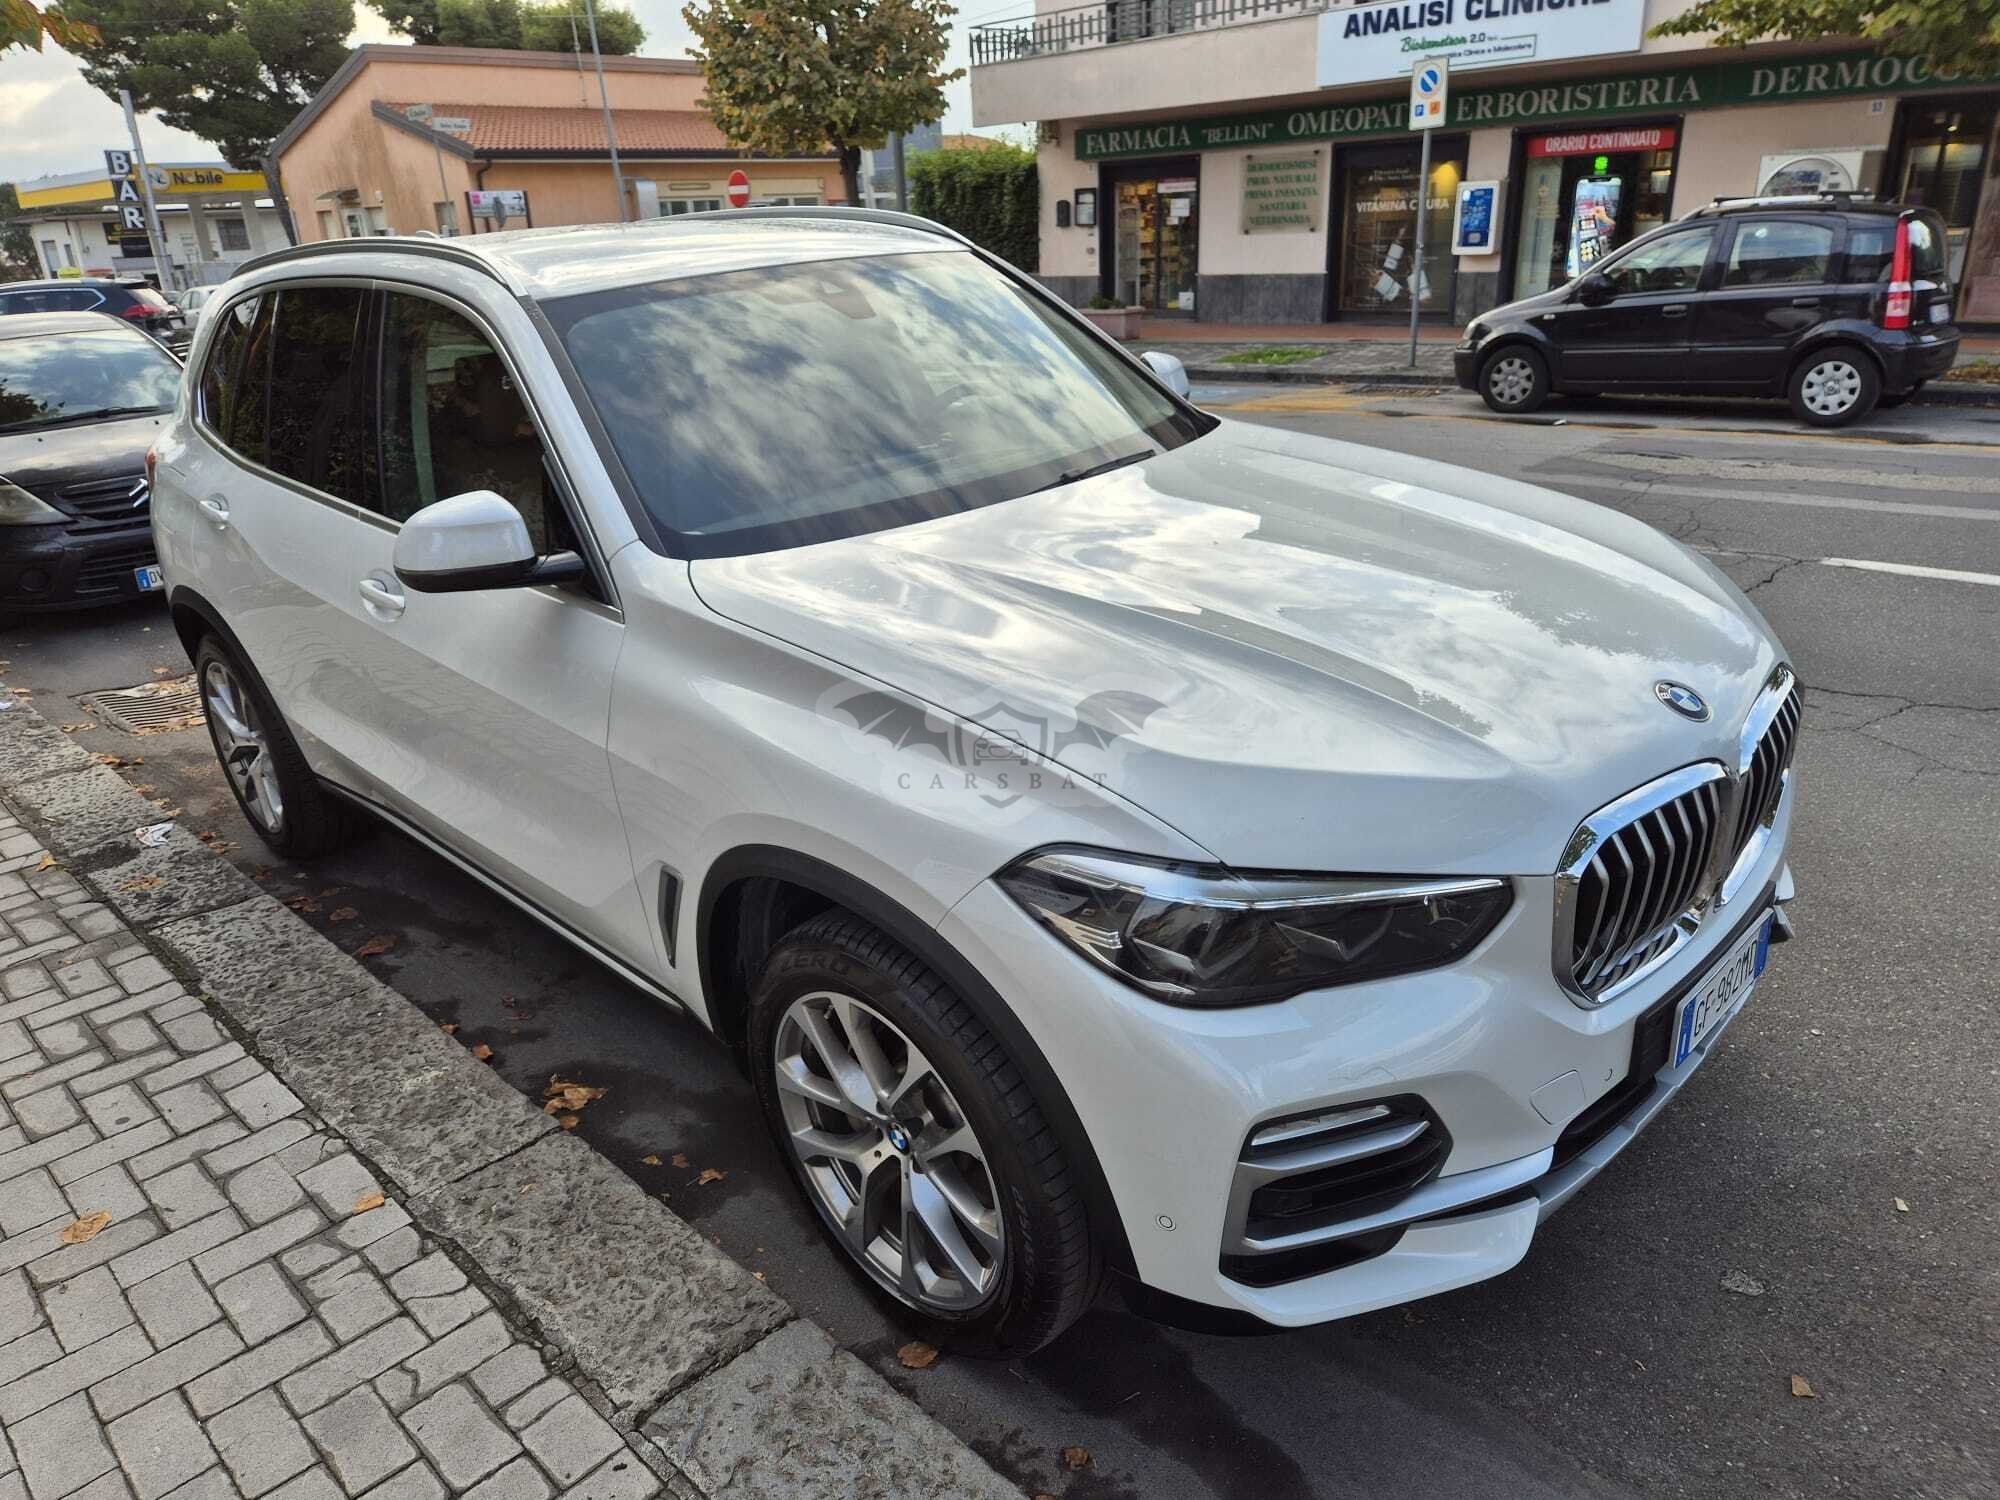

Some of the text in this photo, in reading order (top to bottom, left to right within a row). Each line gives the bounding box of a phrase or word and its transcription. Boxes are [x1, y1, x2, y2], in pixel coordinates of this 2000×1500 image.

[1343, 0, 1611, 38] ANALISI CLINI
[1470, 32, 1486, 43] 2.0
[1085, 125, 1191, 155] FARMACIA
[1287, 102, 1410, 136] OMEOPAT
[1456, 75, 1701, 123] ERBORISTERIA
[1750, 52, 2000, 96] DERMOC
[1545, 129, 1661, 152] ORARIO CONTINUATO
[111, 151, 145, 230] BAR
[1356, 199, 1407, 213] VITAMINA
[1425, 198, 1450, 210] URA
